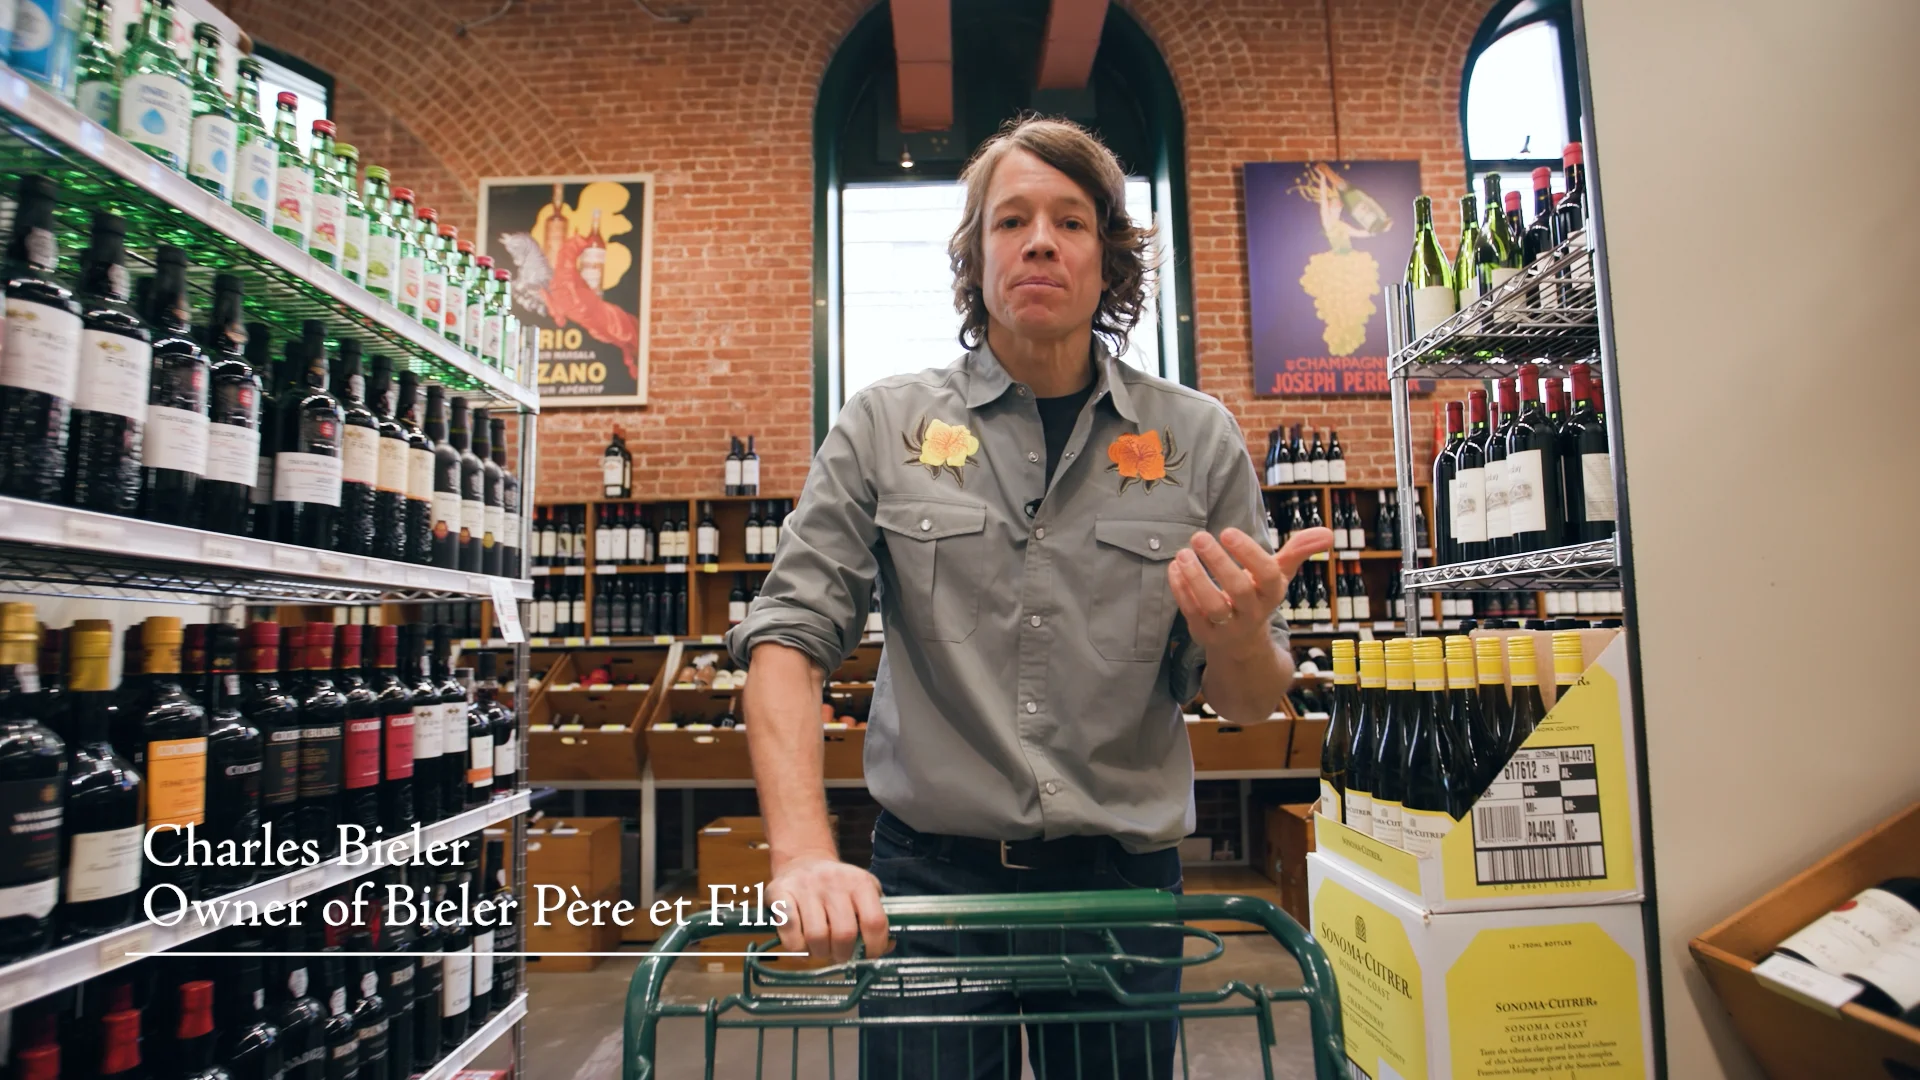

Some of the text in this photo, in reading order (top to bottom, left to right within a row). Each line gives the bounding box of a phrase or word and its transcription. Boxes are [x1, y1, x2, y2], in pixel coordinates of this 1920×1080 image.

[539, 327, 583, 350] RIO
[1296, 355, 1387, 371] CHAMPAGN
[538, 361, 607, 384] ZANO
[1271, 371, 1337, 393] JOSEPH
[1559, 749, 1592, 763] NH-44712
[1504, 760, 1551, 781] 617612 75
[1544, 939, 1572, 947] BOTTLES
[1339, 957, 1391, 1002] SONOMA COAST
[1504, 1019, 1588, 1033] SONOMA COAST
[1510, 1030, 1585, 1043] CHARDONNAY
[1480, 1040, 1617, 1056] Taste the vibrant clarity and focused richness
[1494, 1057, 1506, 1065] this
[1507, 1055, 1545, 1065] Chardonnay
[1546, 1055, 1567, 1063] grown
[1587, 1049, 1613, 1060] complex
[1564, 1063, 1575, 1071] the
[1576, 1061, 1601, 1070] Sonoma
